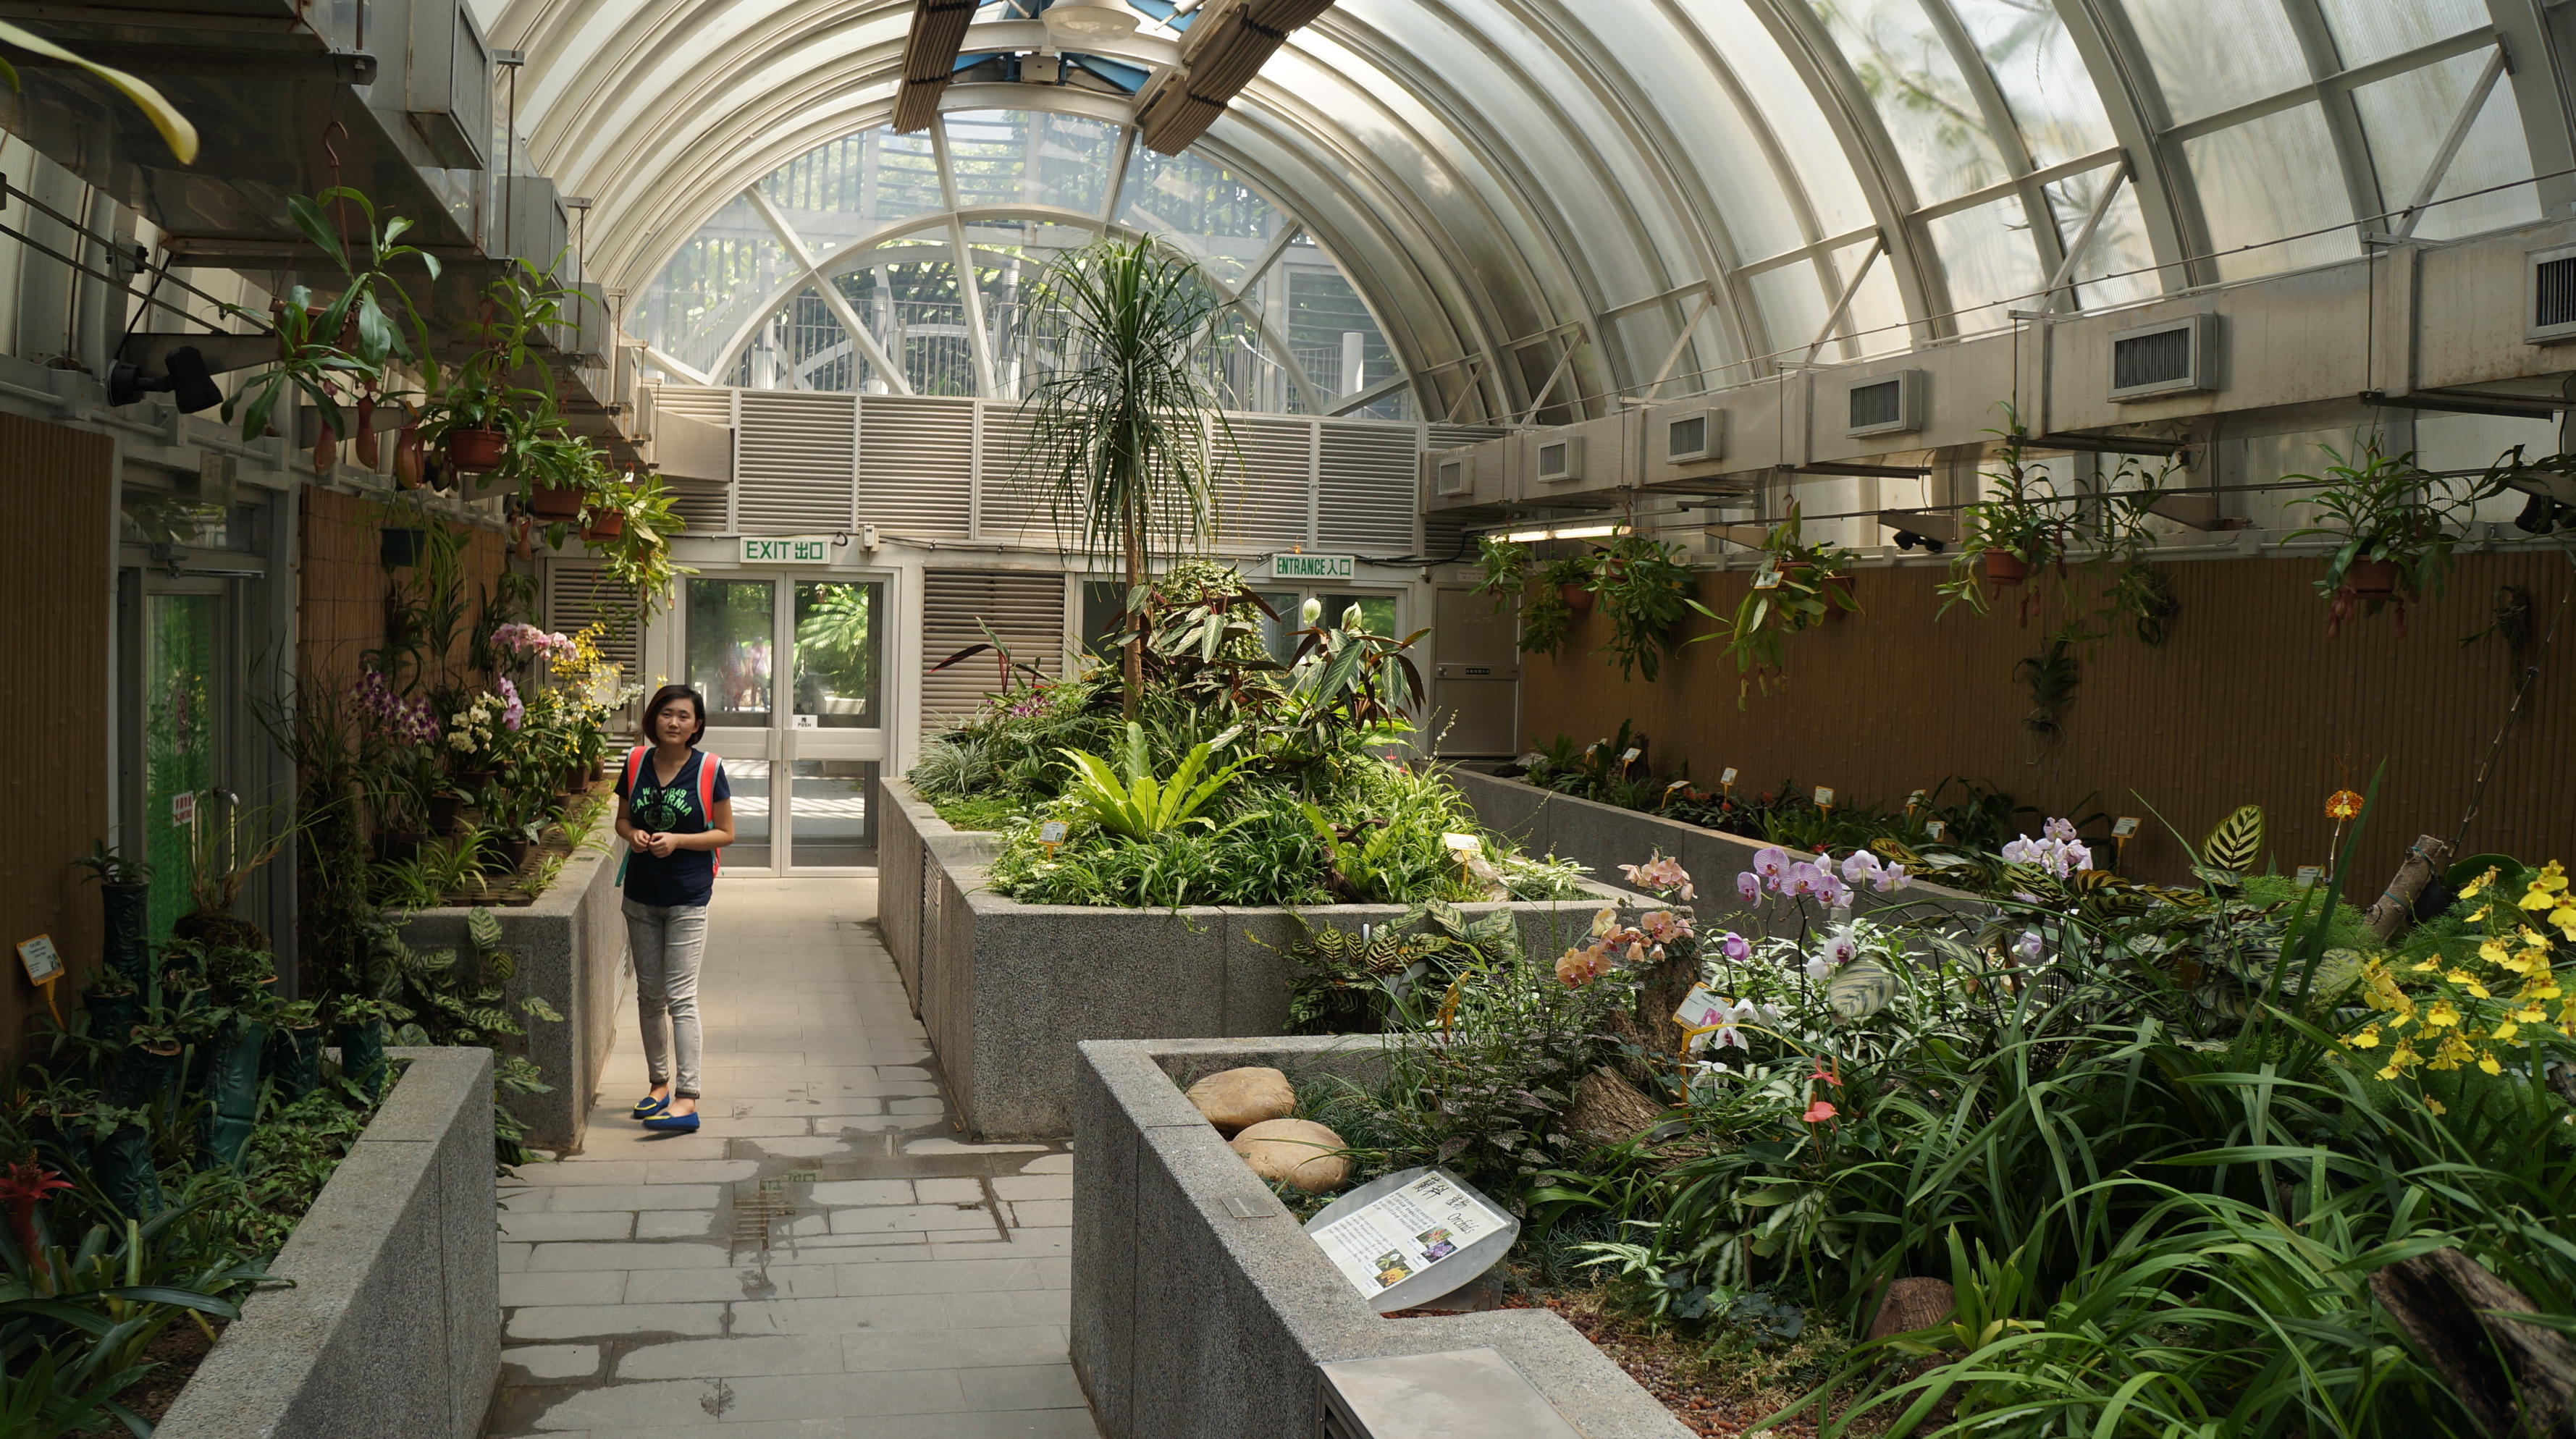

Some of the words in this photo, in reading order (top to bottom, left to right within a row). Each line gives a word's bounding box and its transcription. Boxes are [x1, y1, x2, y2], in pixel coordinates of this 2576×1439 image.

[746, 541, 791, 560] EXIT
[795, 541, 823, 560] 出口
[1276, 557, 1325, 575] ENTRANCE
[1327, 558, 1351, 576] 入口
[631, 793, 693, 817] CALORNIA
[1447, 1212, 1479, 1234] Orchids
